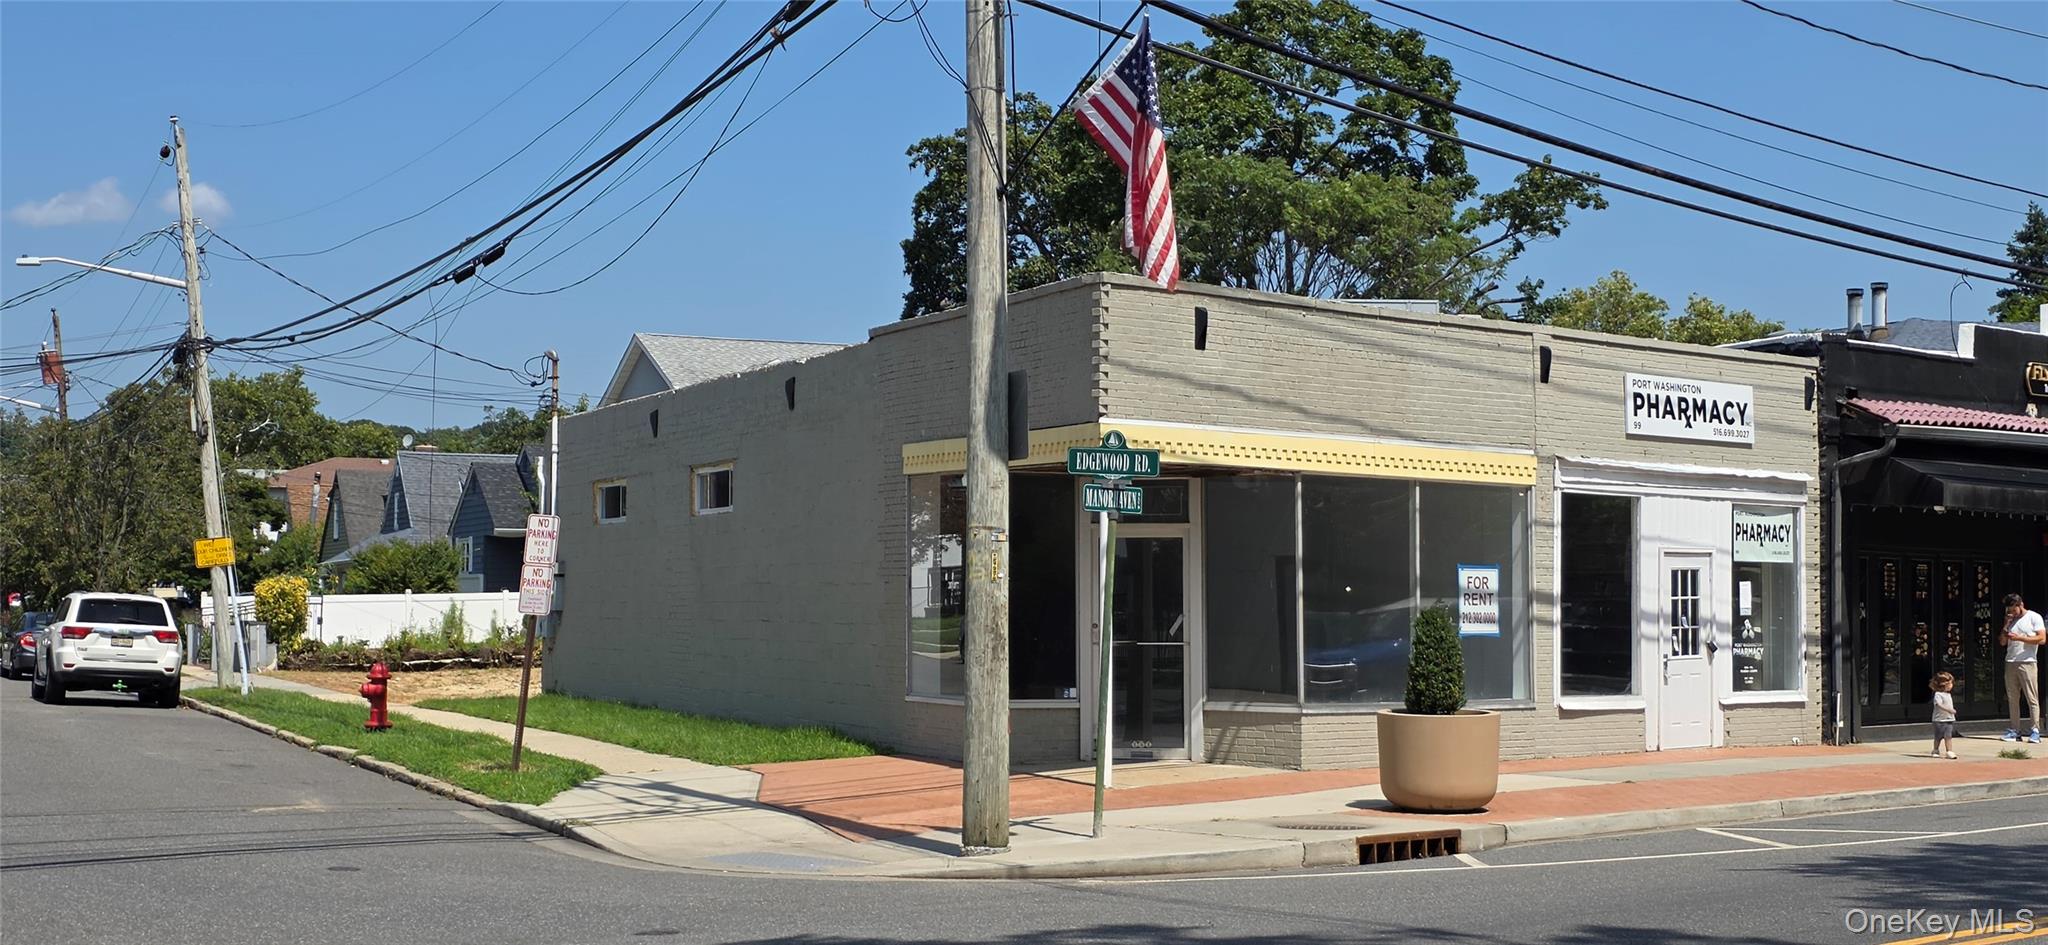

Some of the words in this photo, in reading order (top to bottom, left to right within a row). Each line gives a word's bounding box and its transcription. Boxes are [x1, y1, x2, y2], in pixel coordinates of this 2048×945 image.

[1632, 379, 1651, 389] PORT
[1653, 381, 1702, 394] WASHINGTON
[1633, 392, 1748, 428] PHARMACY
[1633, 421, 1642, 429] 99
[1713, 428, 1750, 438] 516.699.3027
[1076, 452, 1130, 472] EDGEWOOD
[1134, 454, 1151, 473] RD.
[1085, 488, 1137, 509] MANORHAVEN
[538, 518, 550, 528] NO
[528, 529, 556, 540] PARKING
[1735, 522, 1791, 547] PHARMACY
[532, 568, 543, 577] NO
[522, 578, 551, 589] PARKING
[1467, 576, 1489, 589] FOR
[1463, 592, 1494, 606] RENT
